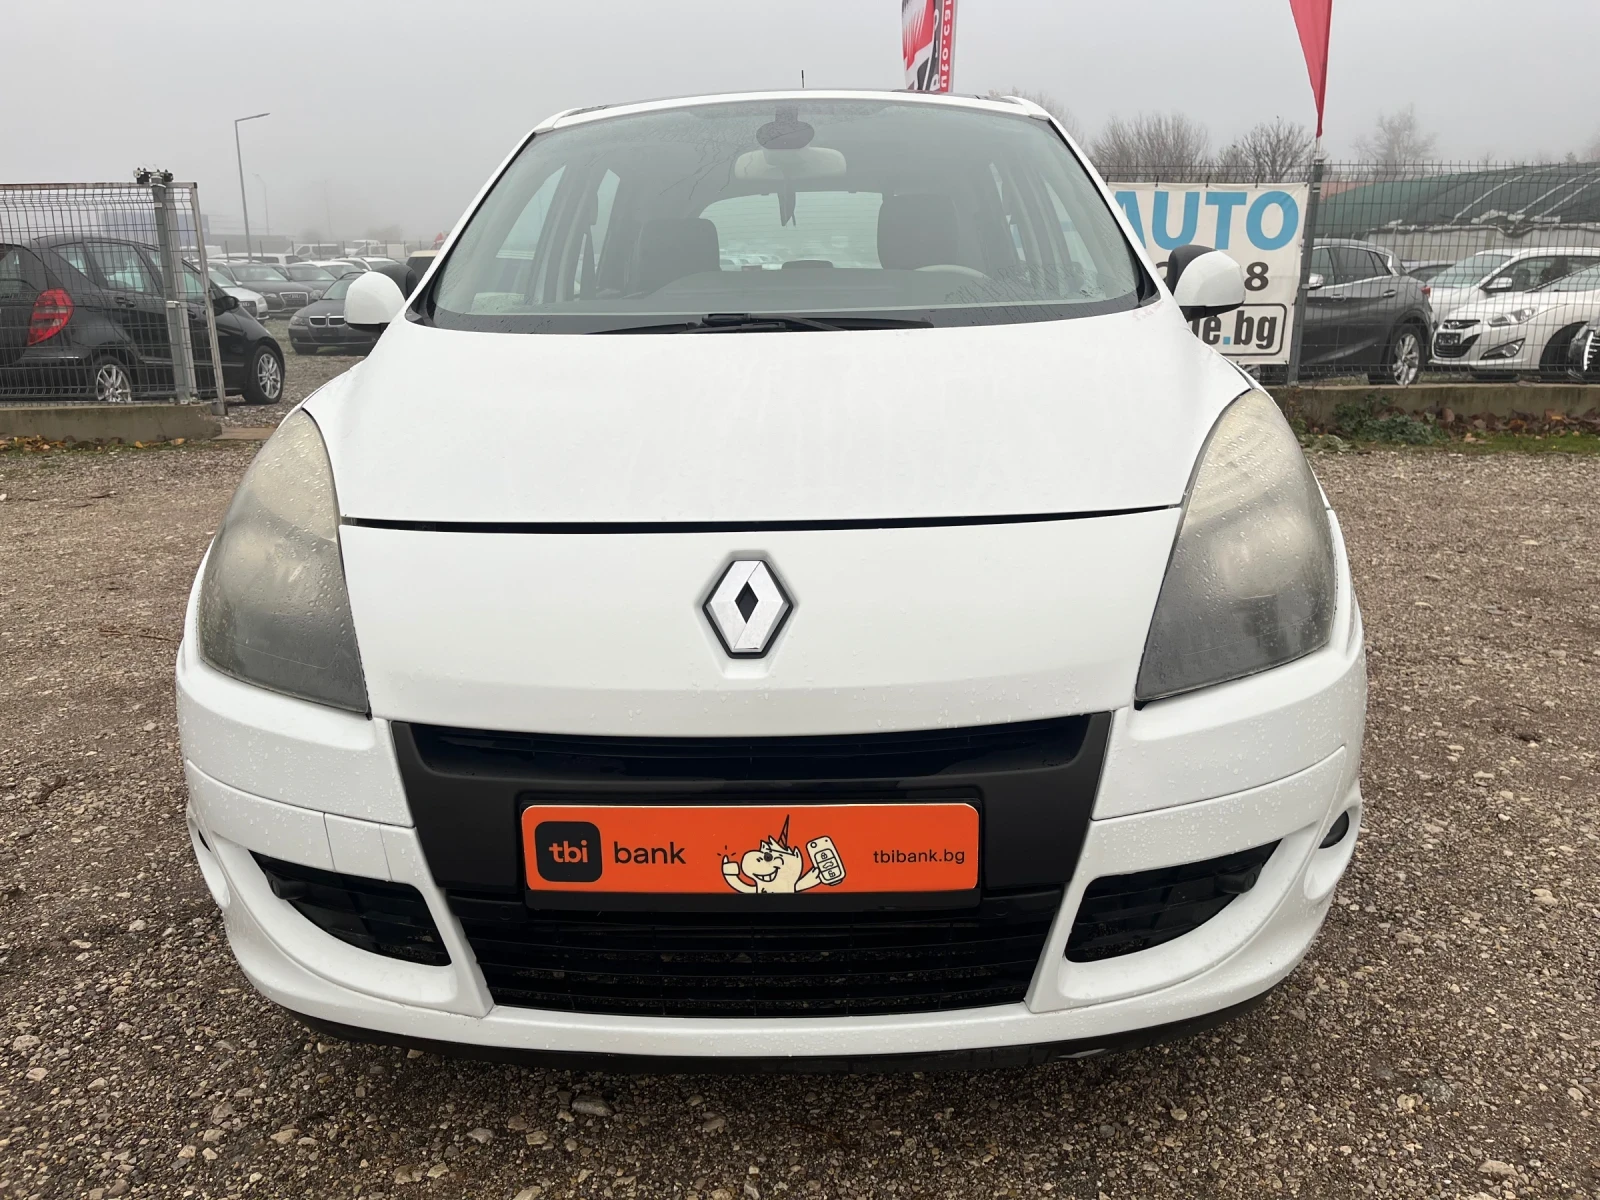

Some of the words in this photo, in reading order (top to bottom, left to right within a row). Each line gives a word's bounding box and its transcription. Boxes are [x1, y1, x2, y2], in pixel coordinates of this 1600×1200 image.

[548, 839, 589, 863] tbi
[613, 841, 686, 864] bank
[873, 848, 965, 865] tbibank.bg
